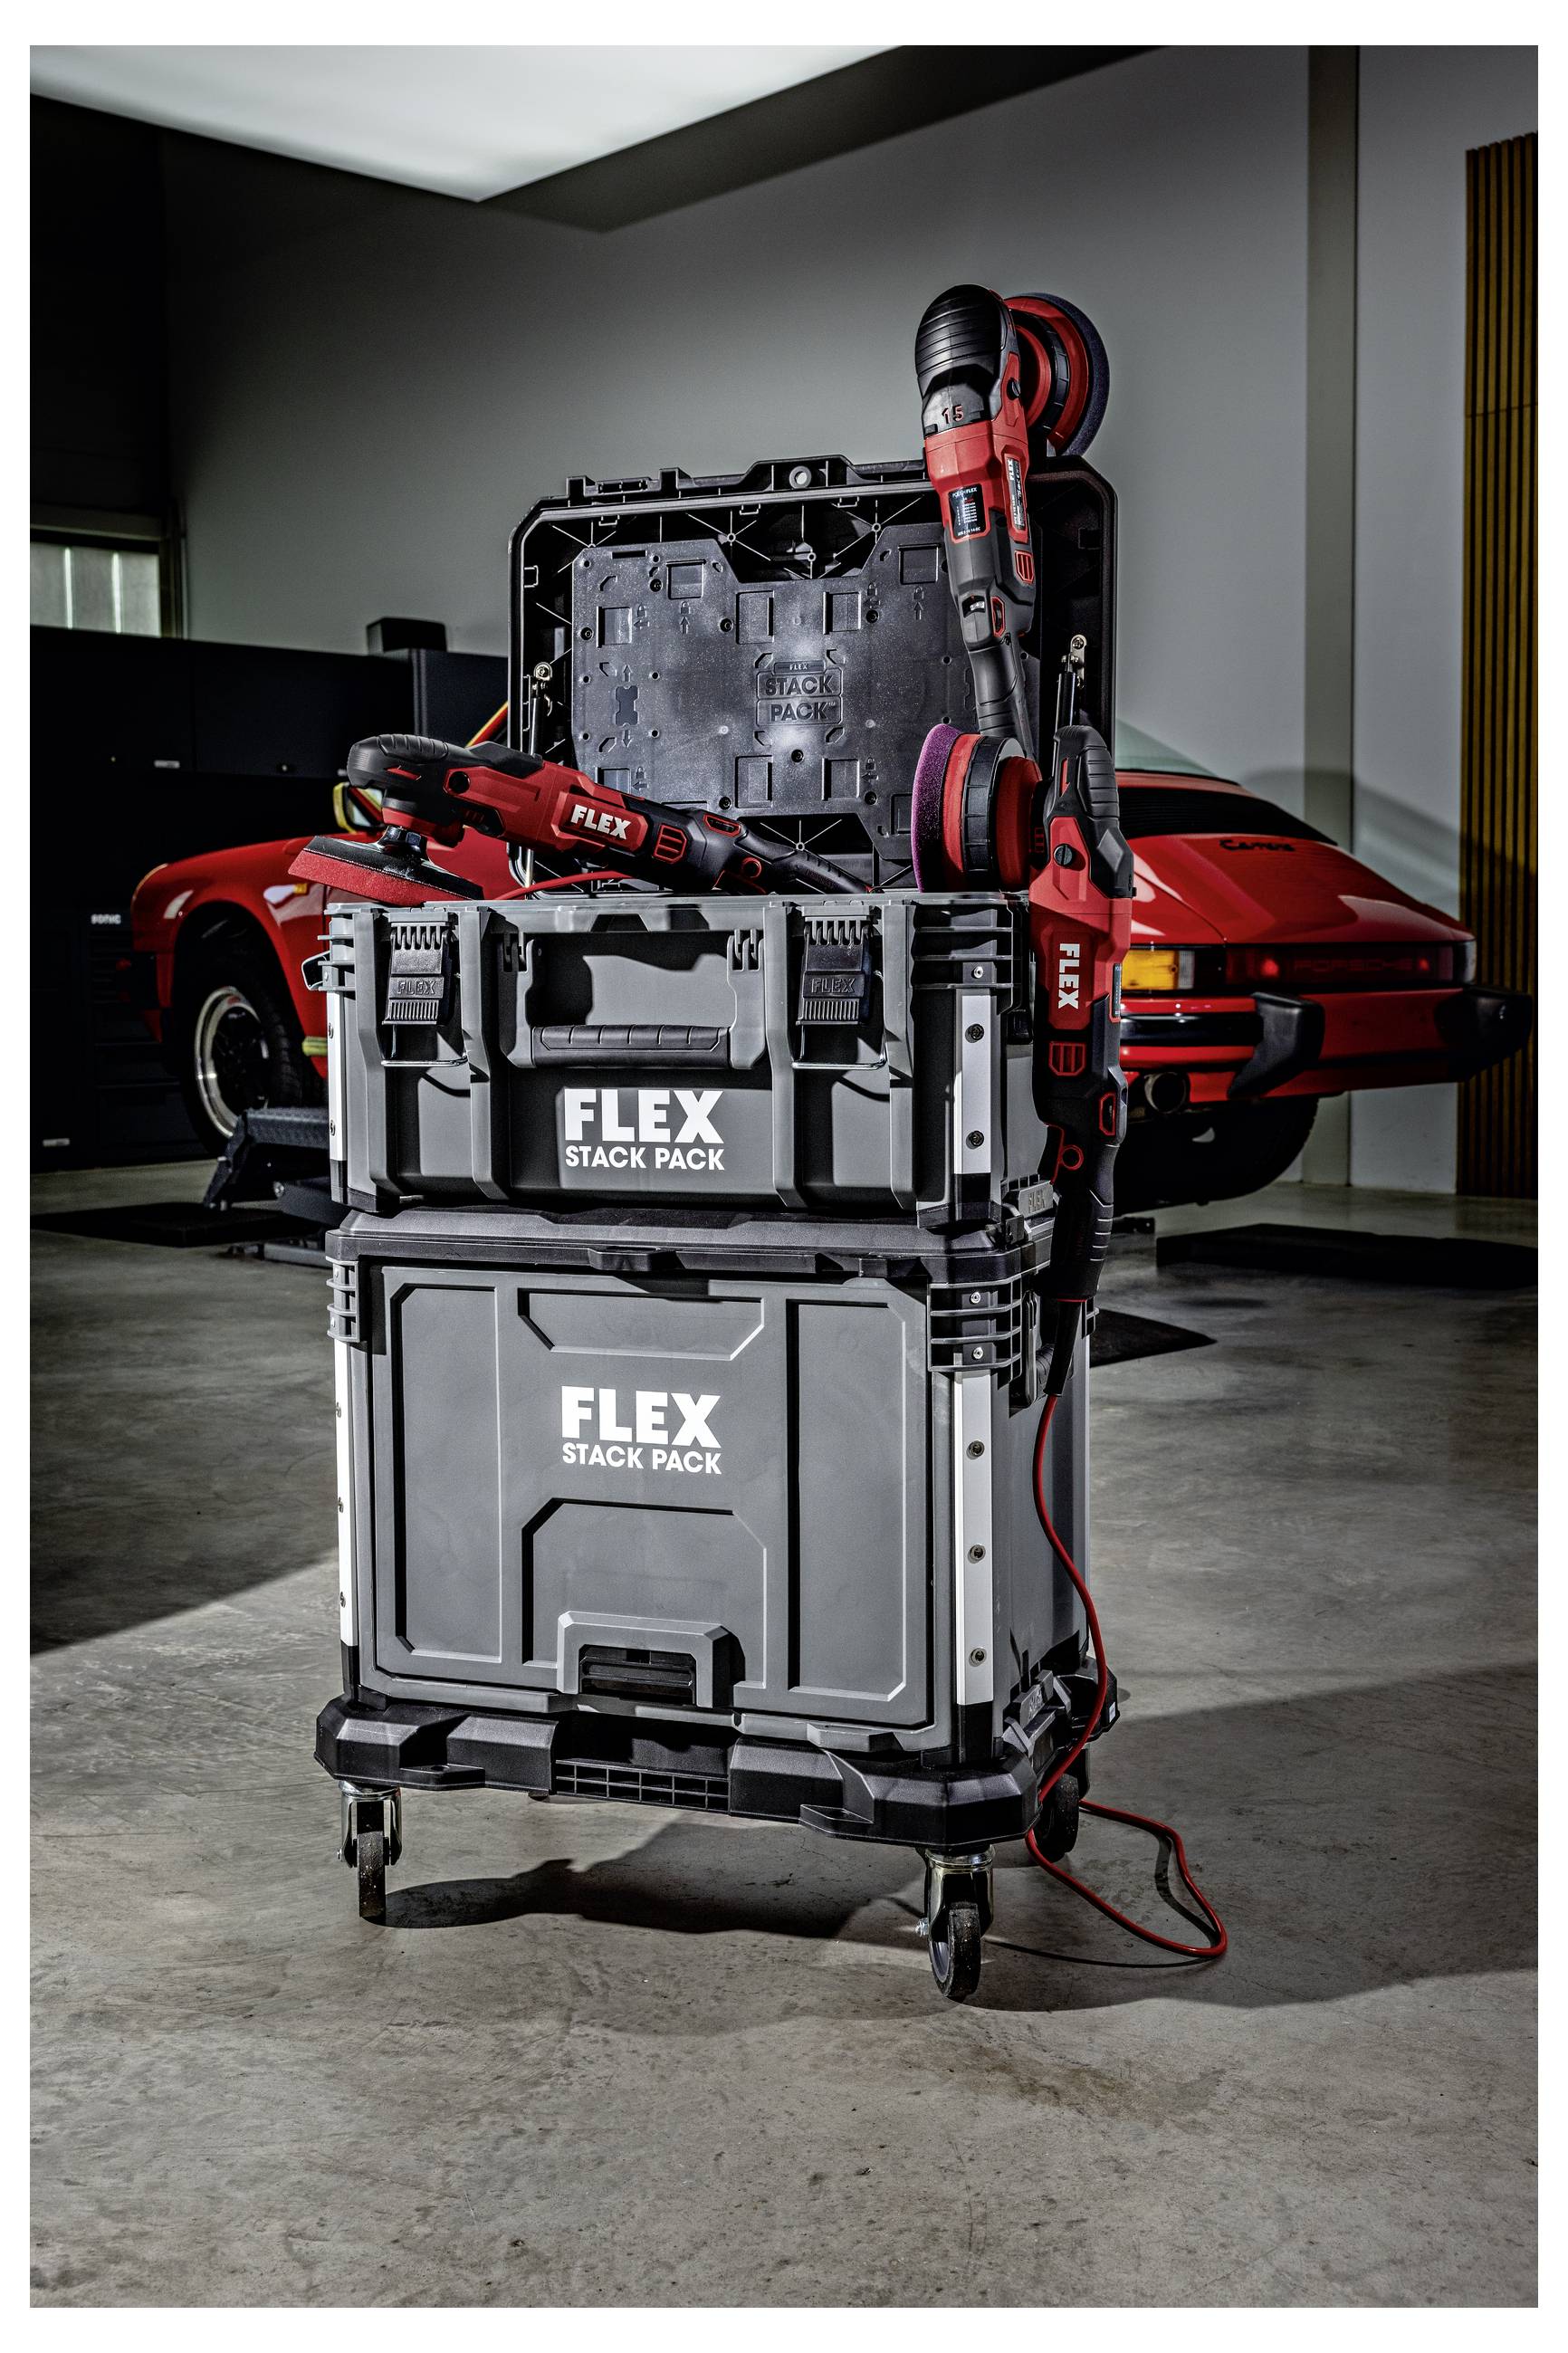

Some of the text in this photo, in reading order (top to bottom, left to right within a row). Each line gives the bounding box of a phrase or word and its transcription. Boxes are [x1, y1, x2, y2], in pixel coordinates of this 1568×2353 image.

[942, 404, 964, 425] 15
[765, 675, 833, 696] STACK
[570, 804, 631, 840] FLEX
[397, 980, 435, 995] FLEX
[810, 978, 856, 993] FLEX
[1058, 943, 1080, 1009] FLEX
[564, 1088, 724, 1143] FLEX
[565, 1145, 724, 1171] STACK PACK
[561, 1386, 722, 1449] FLEX
[562, 1442, 722, 1475] STACK PACK
